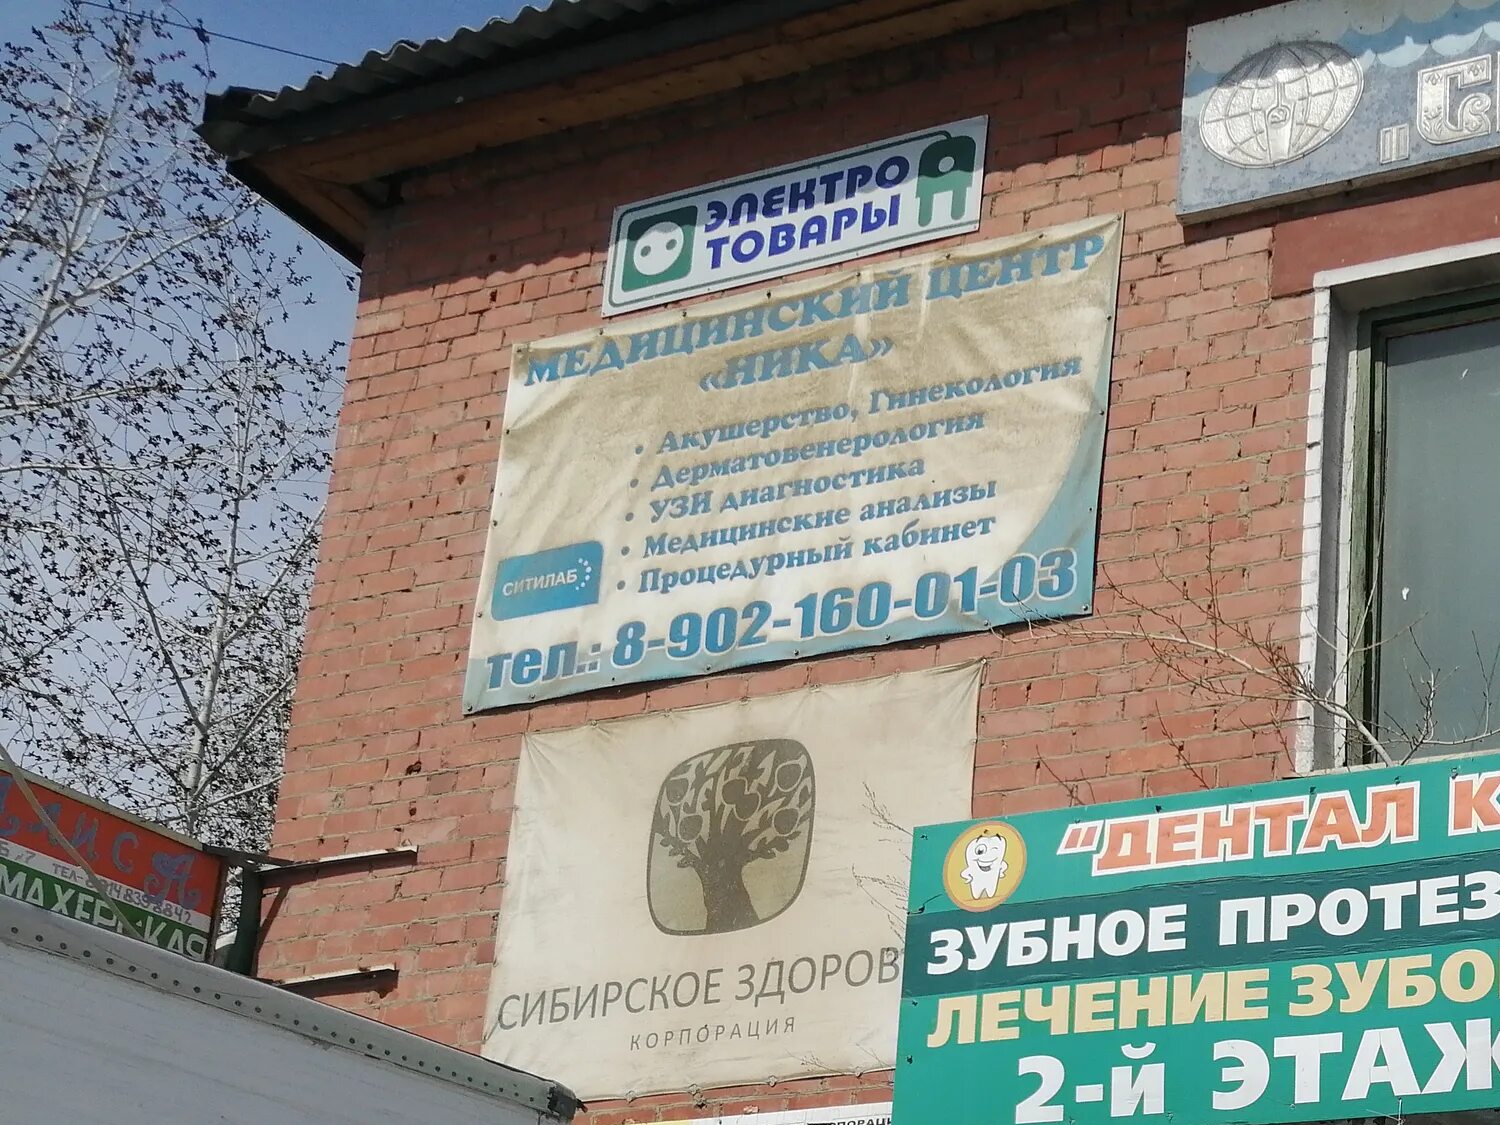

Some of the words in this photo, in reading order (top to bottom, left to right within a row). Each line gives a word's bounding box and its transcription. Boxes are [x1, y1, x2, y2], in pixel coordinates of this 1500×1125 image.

[704, 155, 910, 233] ЭЛЕКТРО
[706, 194, 901, 270] ТОВАРЫ
[523, 266, 912, 387] МЕДИЦИНСКИЙ
[926, 234, 1106, 300] ЦЕНТР
[700, 333, 894, 393] «НИКА»
[656, 402, 857, 455] Акушерство,
[868, 356, 1083, 415] Гинекология
[650, 411, 985, 492] Дерматовенерология
[650, 489, 713, 523] УЗИ
[719, 458, 926, 514] диагностика
[638, 535, 853, 594] Процедурный
[861, 515, 998, 557] кабинет
[642, 506, 850, 559] Медицинские
[860, 480, 998, 522] анализы
[485, 641, 601, 690] тел.:
[611, 547, 1079, 668] 8-902-160-01-03
[502, 568, 577, 596] СИТИЛАБ
[1057, 780, 1421, 877] "ДЕНТАЛ
[0, 864, 208, 962] МАХЕРКАЯ
[926, 903, 1188, 976] ЗУБНОЕ
[497, 967, 724, 1032] СИБИРСКОЕ
[629, 1016, 796, 1051] КОРПОРАЦИЯ
[926, 969, 1270, 1049] ЛЕЧЕНИЕ
